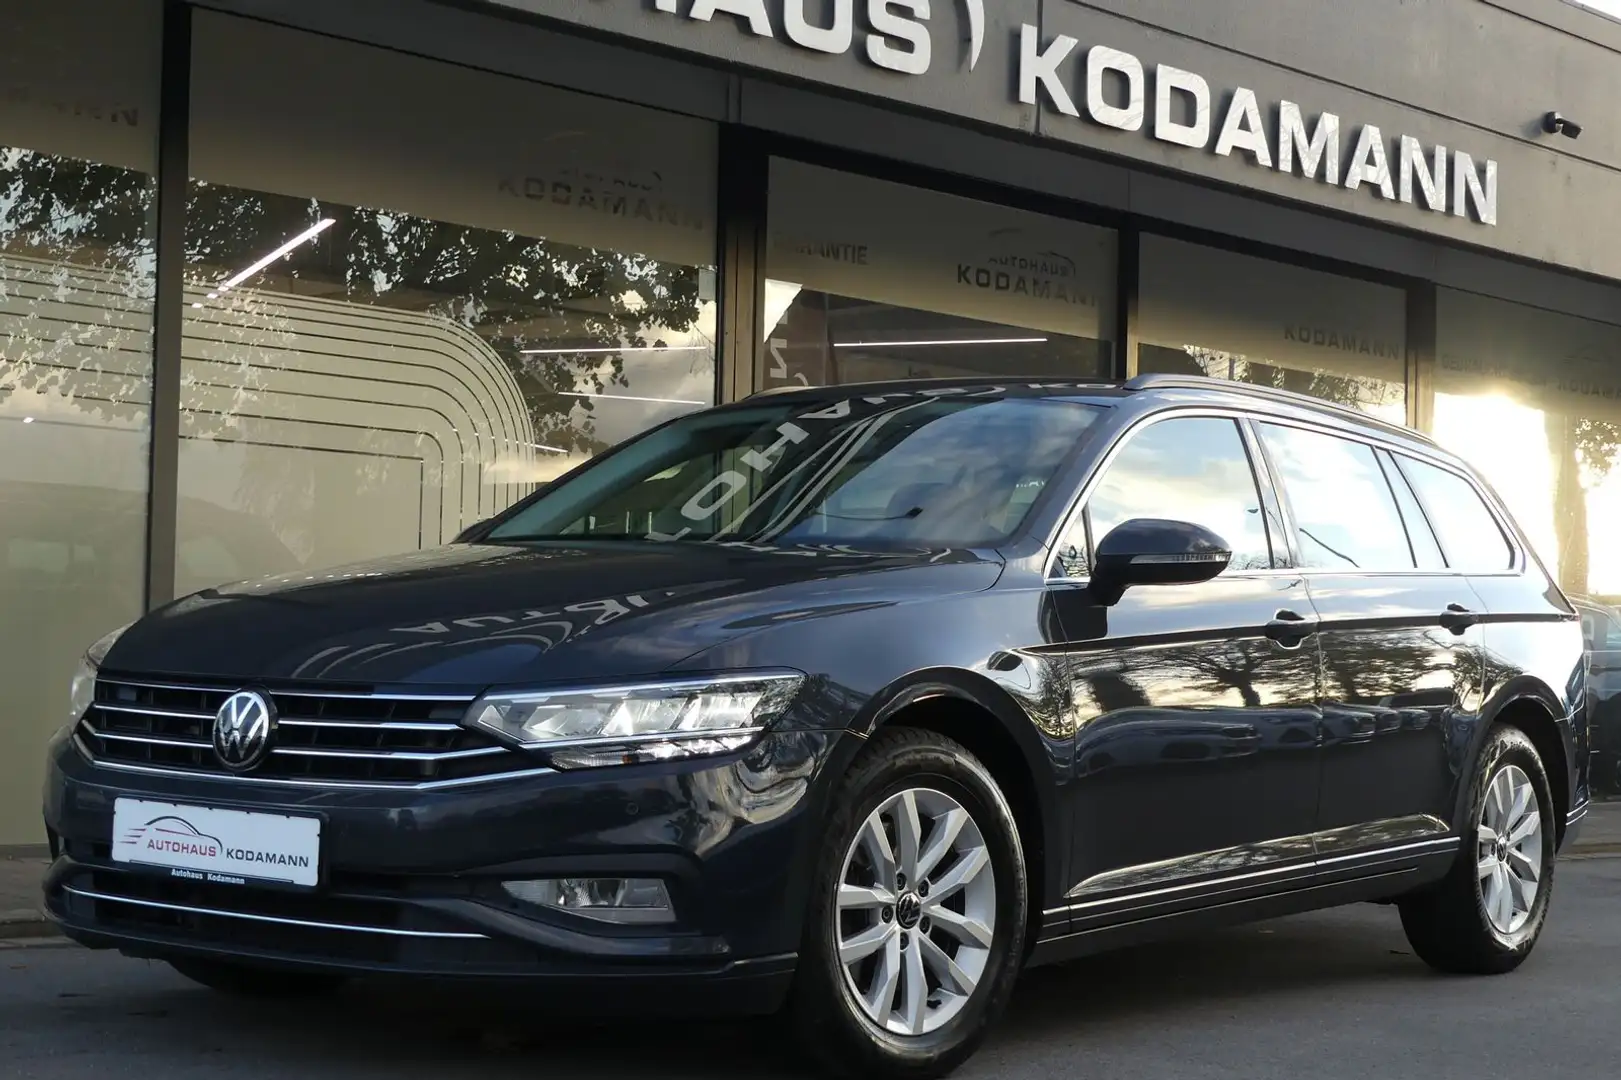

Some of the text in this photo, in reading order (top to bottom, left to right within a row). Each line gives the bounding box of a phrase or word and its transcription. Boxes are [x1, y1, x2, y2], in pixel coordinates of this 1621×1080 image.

[652, 0, 1497, 226] US KODAMANN
[1283, 323, 1399, 361] KODAMANN
[214, 692, 269, 766] VW
[147, 838, 309, 868] AUTOHAUS KODAMANN
[171, 868, 245, 885] Autohaus Kodamann
